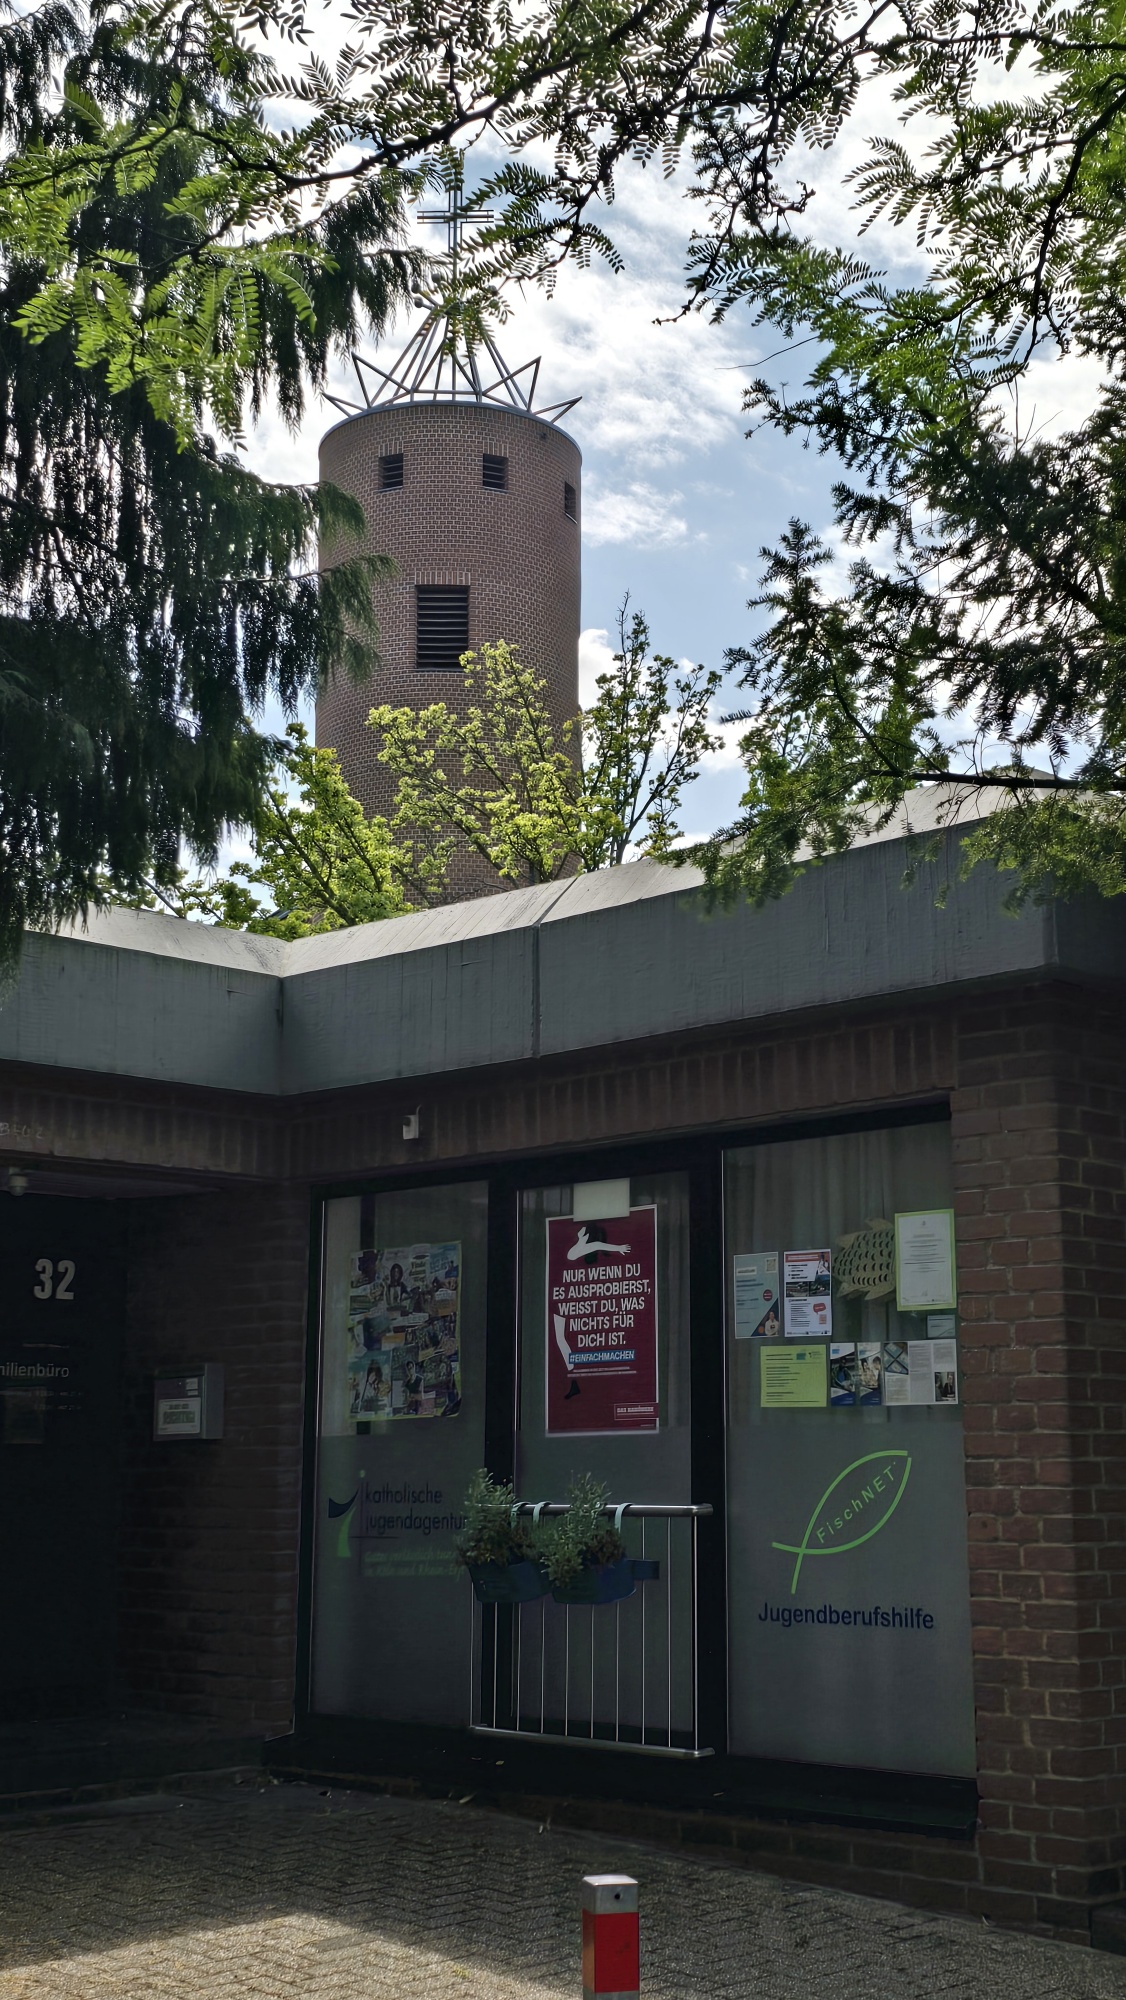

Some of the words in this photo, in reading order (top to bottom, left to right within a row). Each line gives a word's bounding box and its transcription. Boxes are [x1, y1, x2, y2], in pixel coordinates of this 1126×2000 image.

[33, 1258, 76, 1300] 32
[562, 1269, 586, 1283] NUR
[588, 1265, 622, 1280] WENN
[625, 1263, 641, 1277] DU
[553, 1287, 565, 1300] ES
[567, 1279, 651, 1299] AUSPROBIERST,
[558, 1301, 598, 1315] WEISST
[600, 1299, 619, 1314] DU,
[621, 1297, 645, 1311] WAS
[569, 1316, 610, 1331] NICHTS
[612, 1311, 634, 1328] FÜR
[577, 1333, 605, 1348] DICH
[608, 1332, 626, 1345] IST.
[569, 1350, 635, 1362] #EINFACHMACHEN
[365, 1481, 443, 1504] katholische
[815, 1465, 896, 1544] FischNET
[758, 1602, 934, 1630] Jugendberufshilfe
